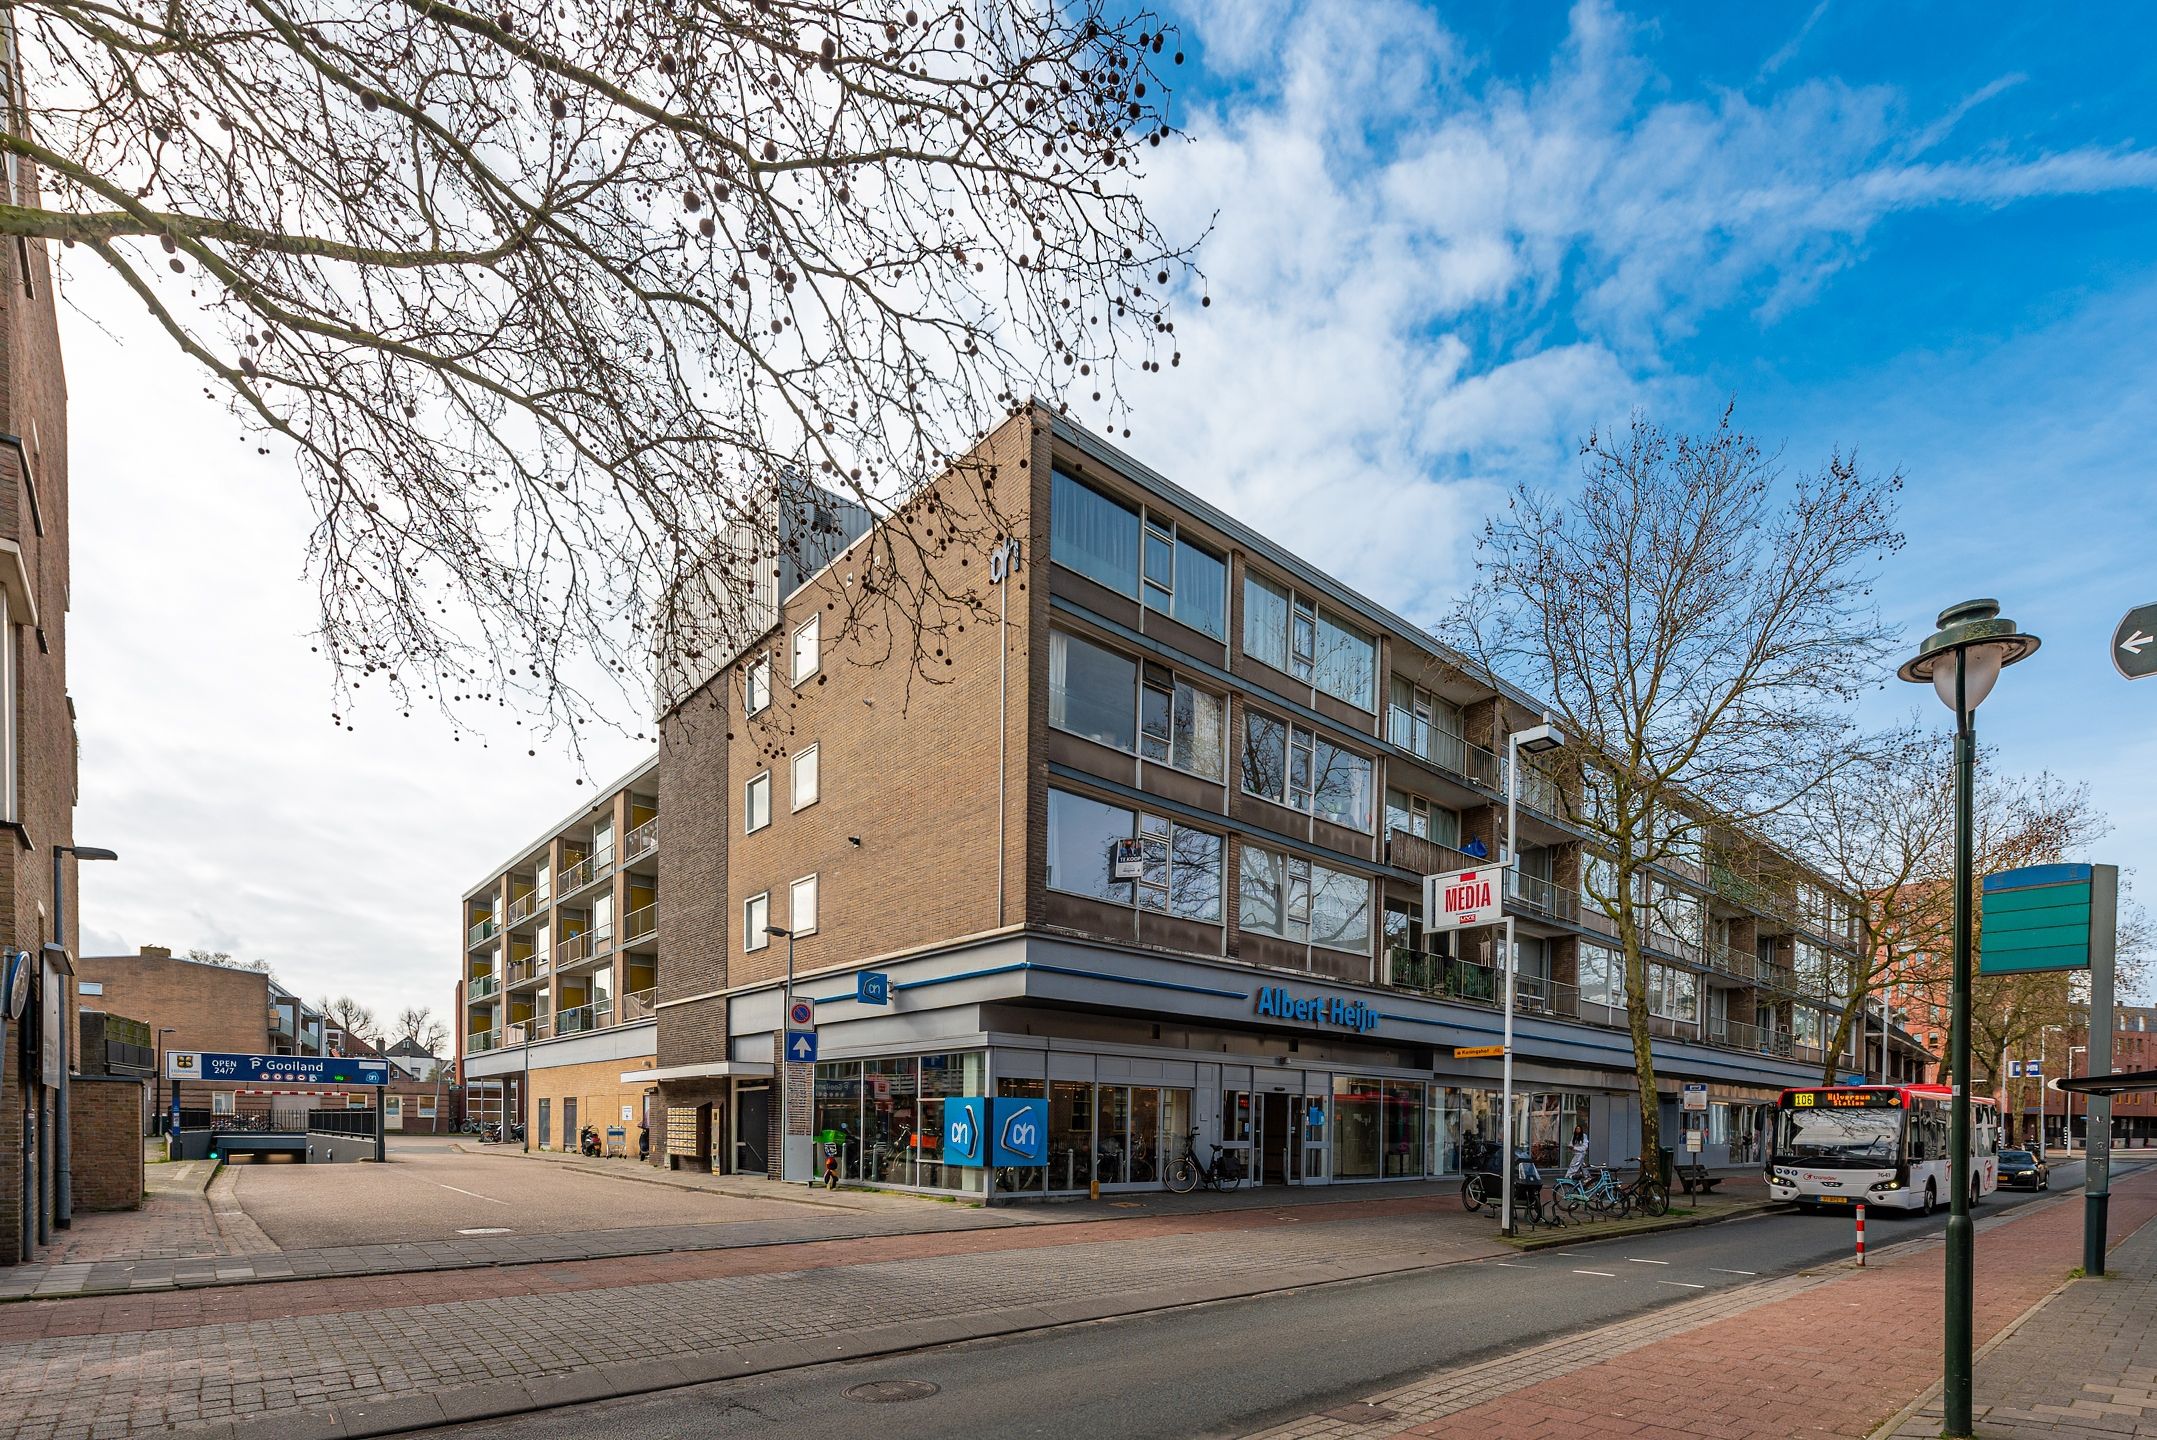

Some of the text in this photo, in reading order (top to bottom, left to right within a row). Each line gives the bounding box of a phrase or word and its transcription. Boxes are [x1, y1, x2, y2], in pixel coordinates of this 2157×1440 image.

[1445, 882, 1491, 913] MEDIA
[1257, 986, 1379, 1033] Albert Heijn
[211, 1059, 237, 1067] OPEN
[266, 1060, 324, 1072] Gooiland
[1796, 1094, 1813, 1105] 106
[1827, 1092, 1871, 1100] Hilversum
